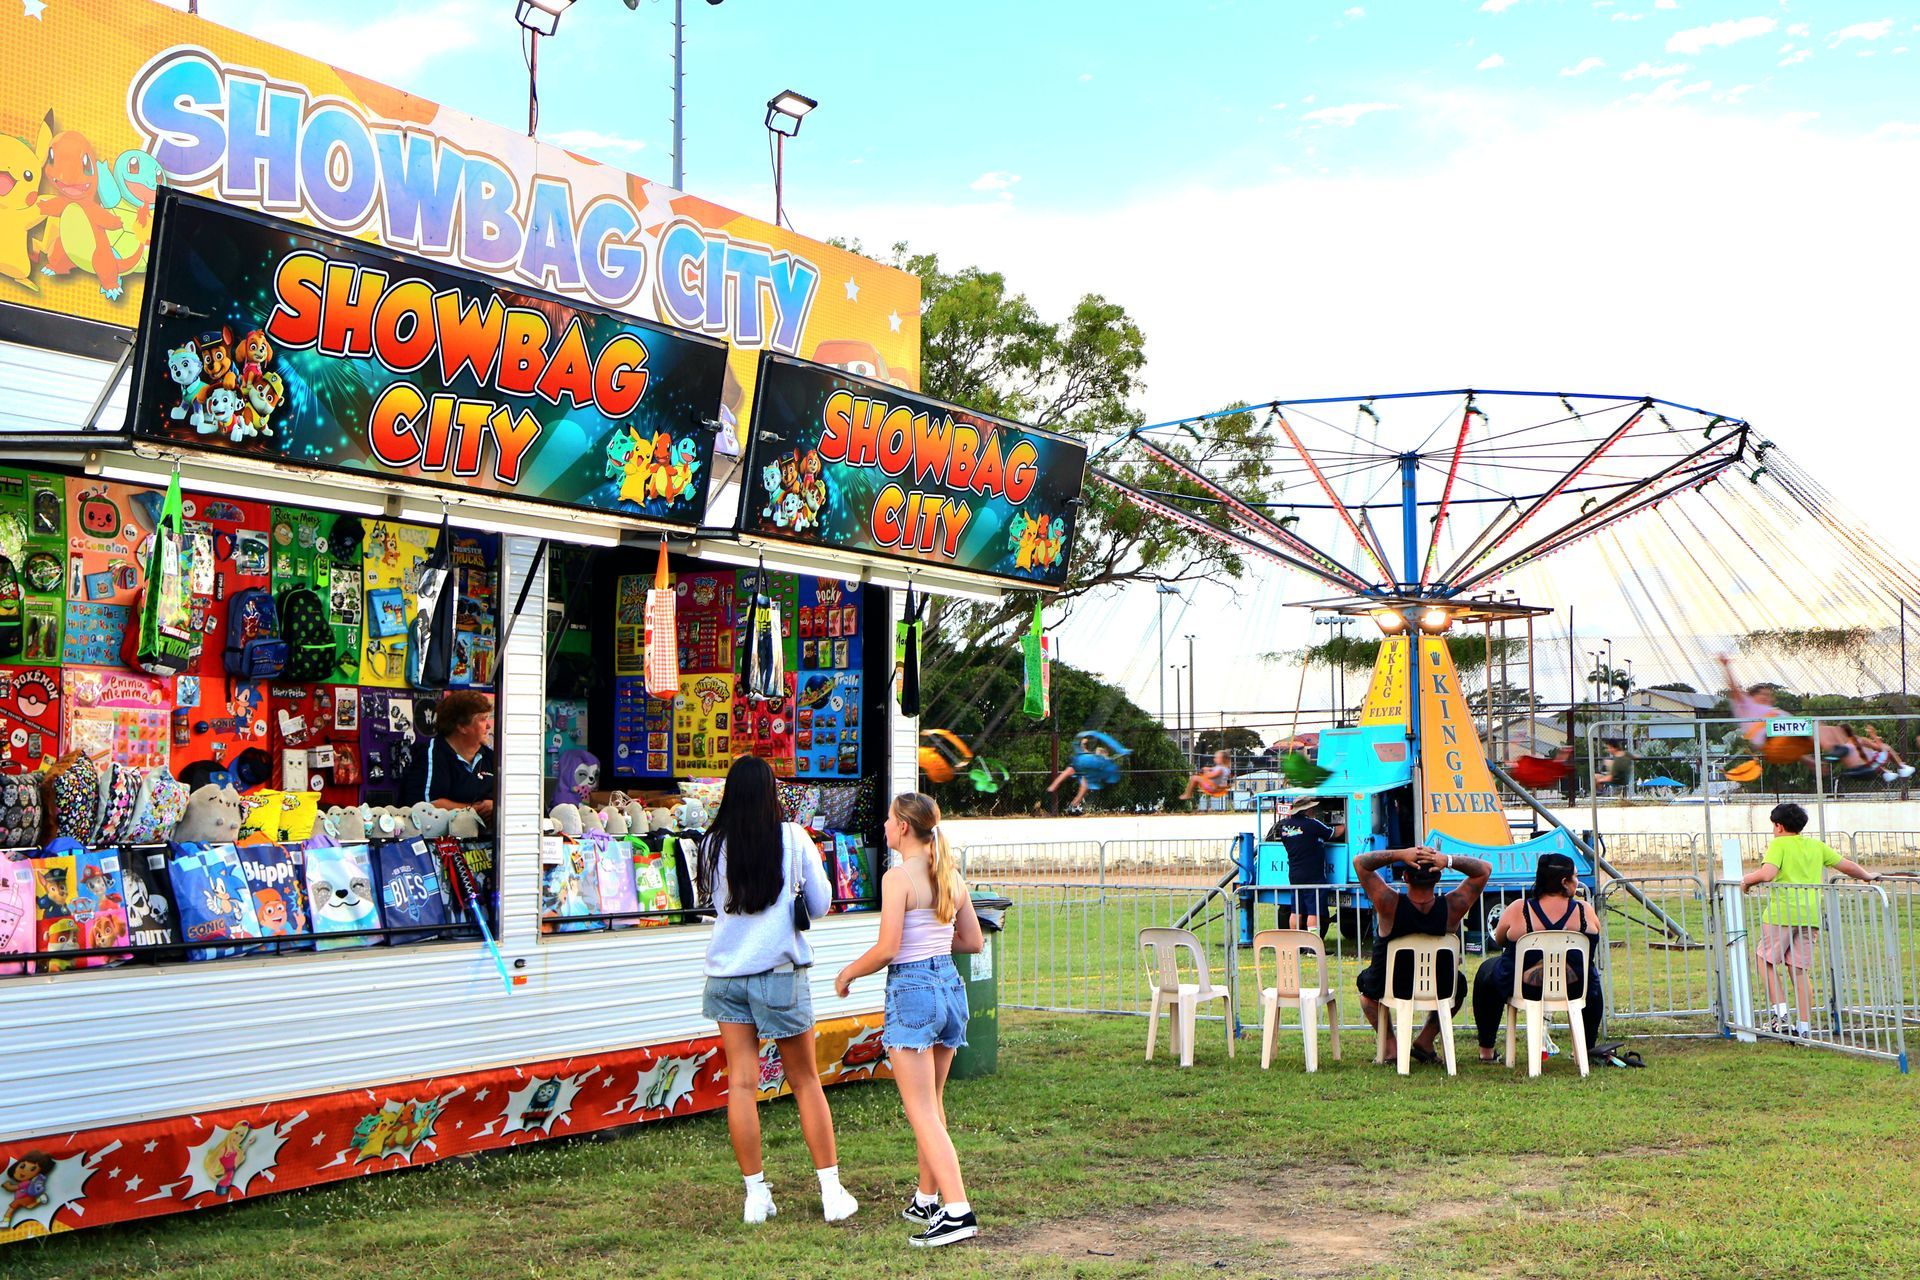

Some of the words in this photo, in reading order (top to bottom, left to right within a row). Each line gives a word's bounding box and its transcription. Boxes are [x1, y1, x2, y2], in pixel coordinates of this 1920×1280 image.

[130, 46, 646, 306] SHOWBAG
[657, 216, 820, 354] CITY
[265, 249, 650, 419] SHOWBAG
[368, 381, 541, 486] CITY
[817, 389, 1039, 505] SHOWBAG
[871, 482, 972, 558] CITY
[452, 554, 486, 566] TRUCKS
[453, 545, 483, 555] MONSTER
[815, 588, 841, 603] POCKY
[12, 669, 59, 700] POKÉMON
[834, 672, 859, 686] Trolli
[1383, 653, 1395, 698] KING
[1369, 706, 1402, 717] FLYER
[256, 724, 265, 732] $35
[1432, 674, 1463, 771] KING
[1773, 722, 1807, 732] ENTRY
[14, 734, 25, 743] $35
[1428, 792, 1499, 814] FLYER
[244, 860, 294, 887] Blippi
[137, 929, 171, 946] DUTY
[187, 918, 226, 939] SONIC
